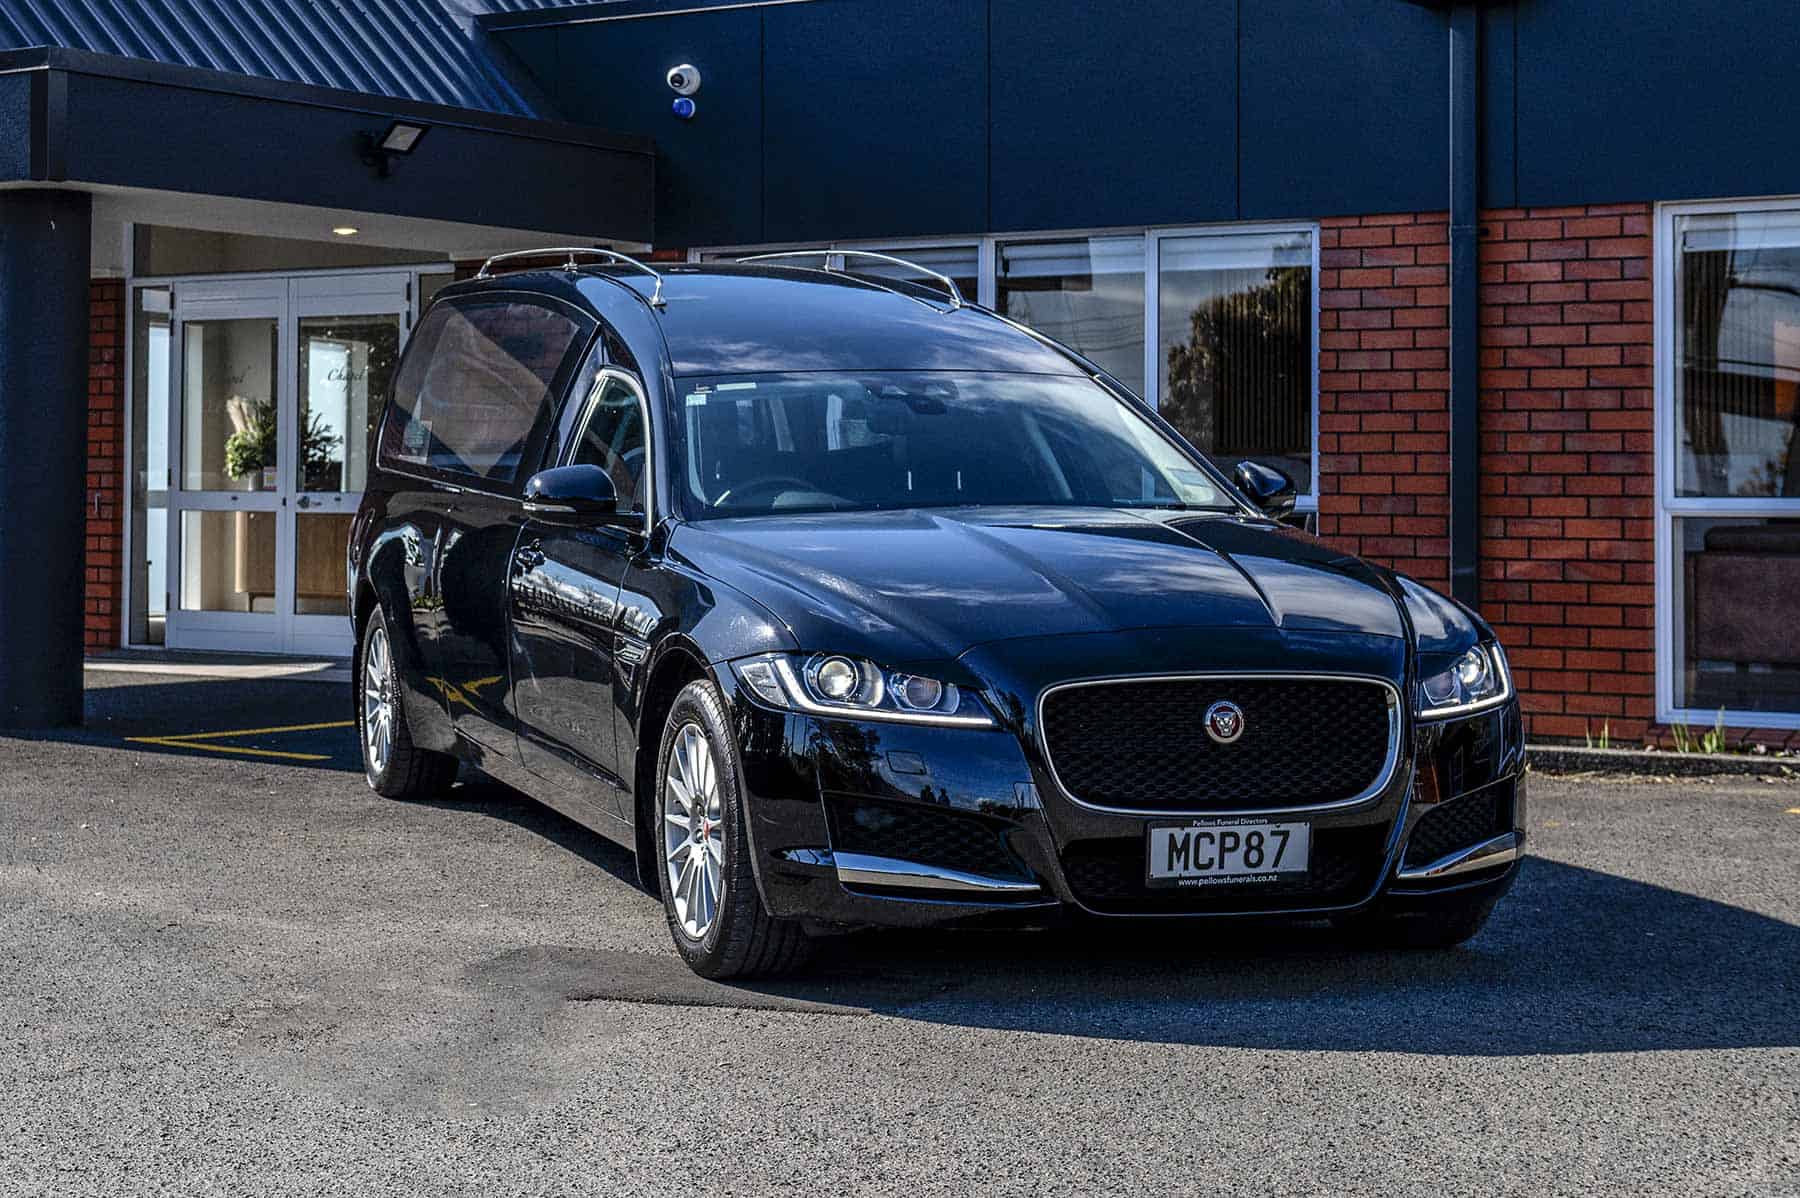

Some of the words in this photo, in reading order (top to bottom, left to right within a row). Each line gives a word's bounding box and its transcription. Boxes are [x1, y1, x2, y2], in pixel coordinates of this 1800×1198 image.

[1217, 818, 1239, 826] Funeral
[1240, 817, 1268, 825] Directors
[1167, 830, 1291, 872] MCP87
[1178, 874, 1278, 887] www.pellowsfunerals.co.nz
